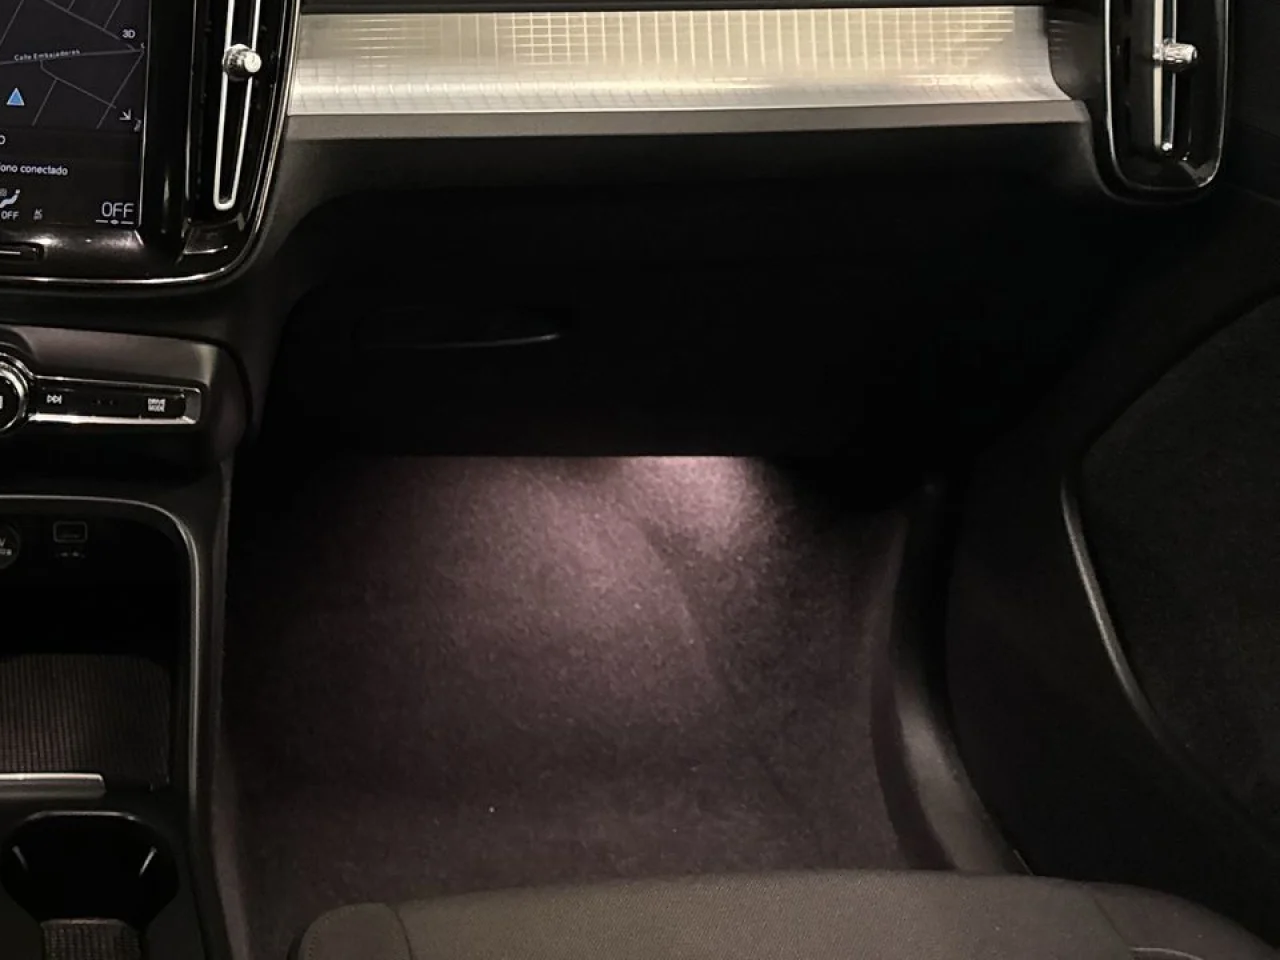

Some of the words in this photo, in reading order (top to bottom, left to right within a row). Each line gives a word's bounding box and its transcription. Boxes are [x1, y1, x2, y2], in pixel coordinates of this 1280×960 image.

[122, 28, 136, 39] 3D
[20, 164, 69, 176] conectado
[0, 210, 20, 220] OFF
[101, 202, 135, 218] OFF
